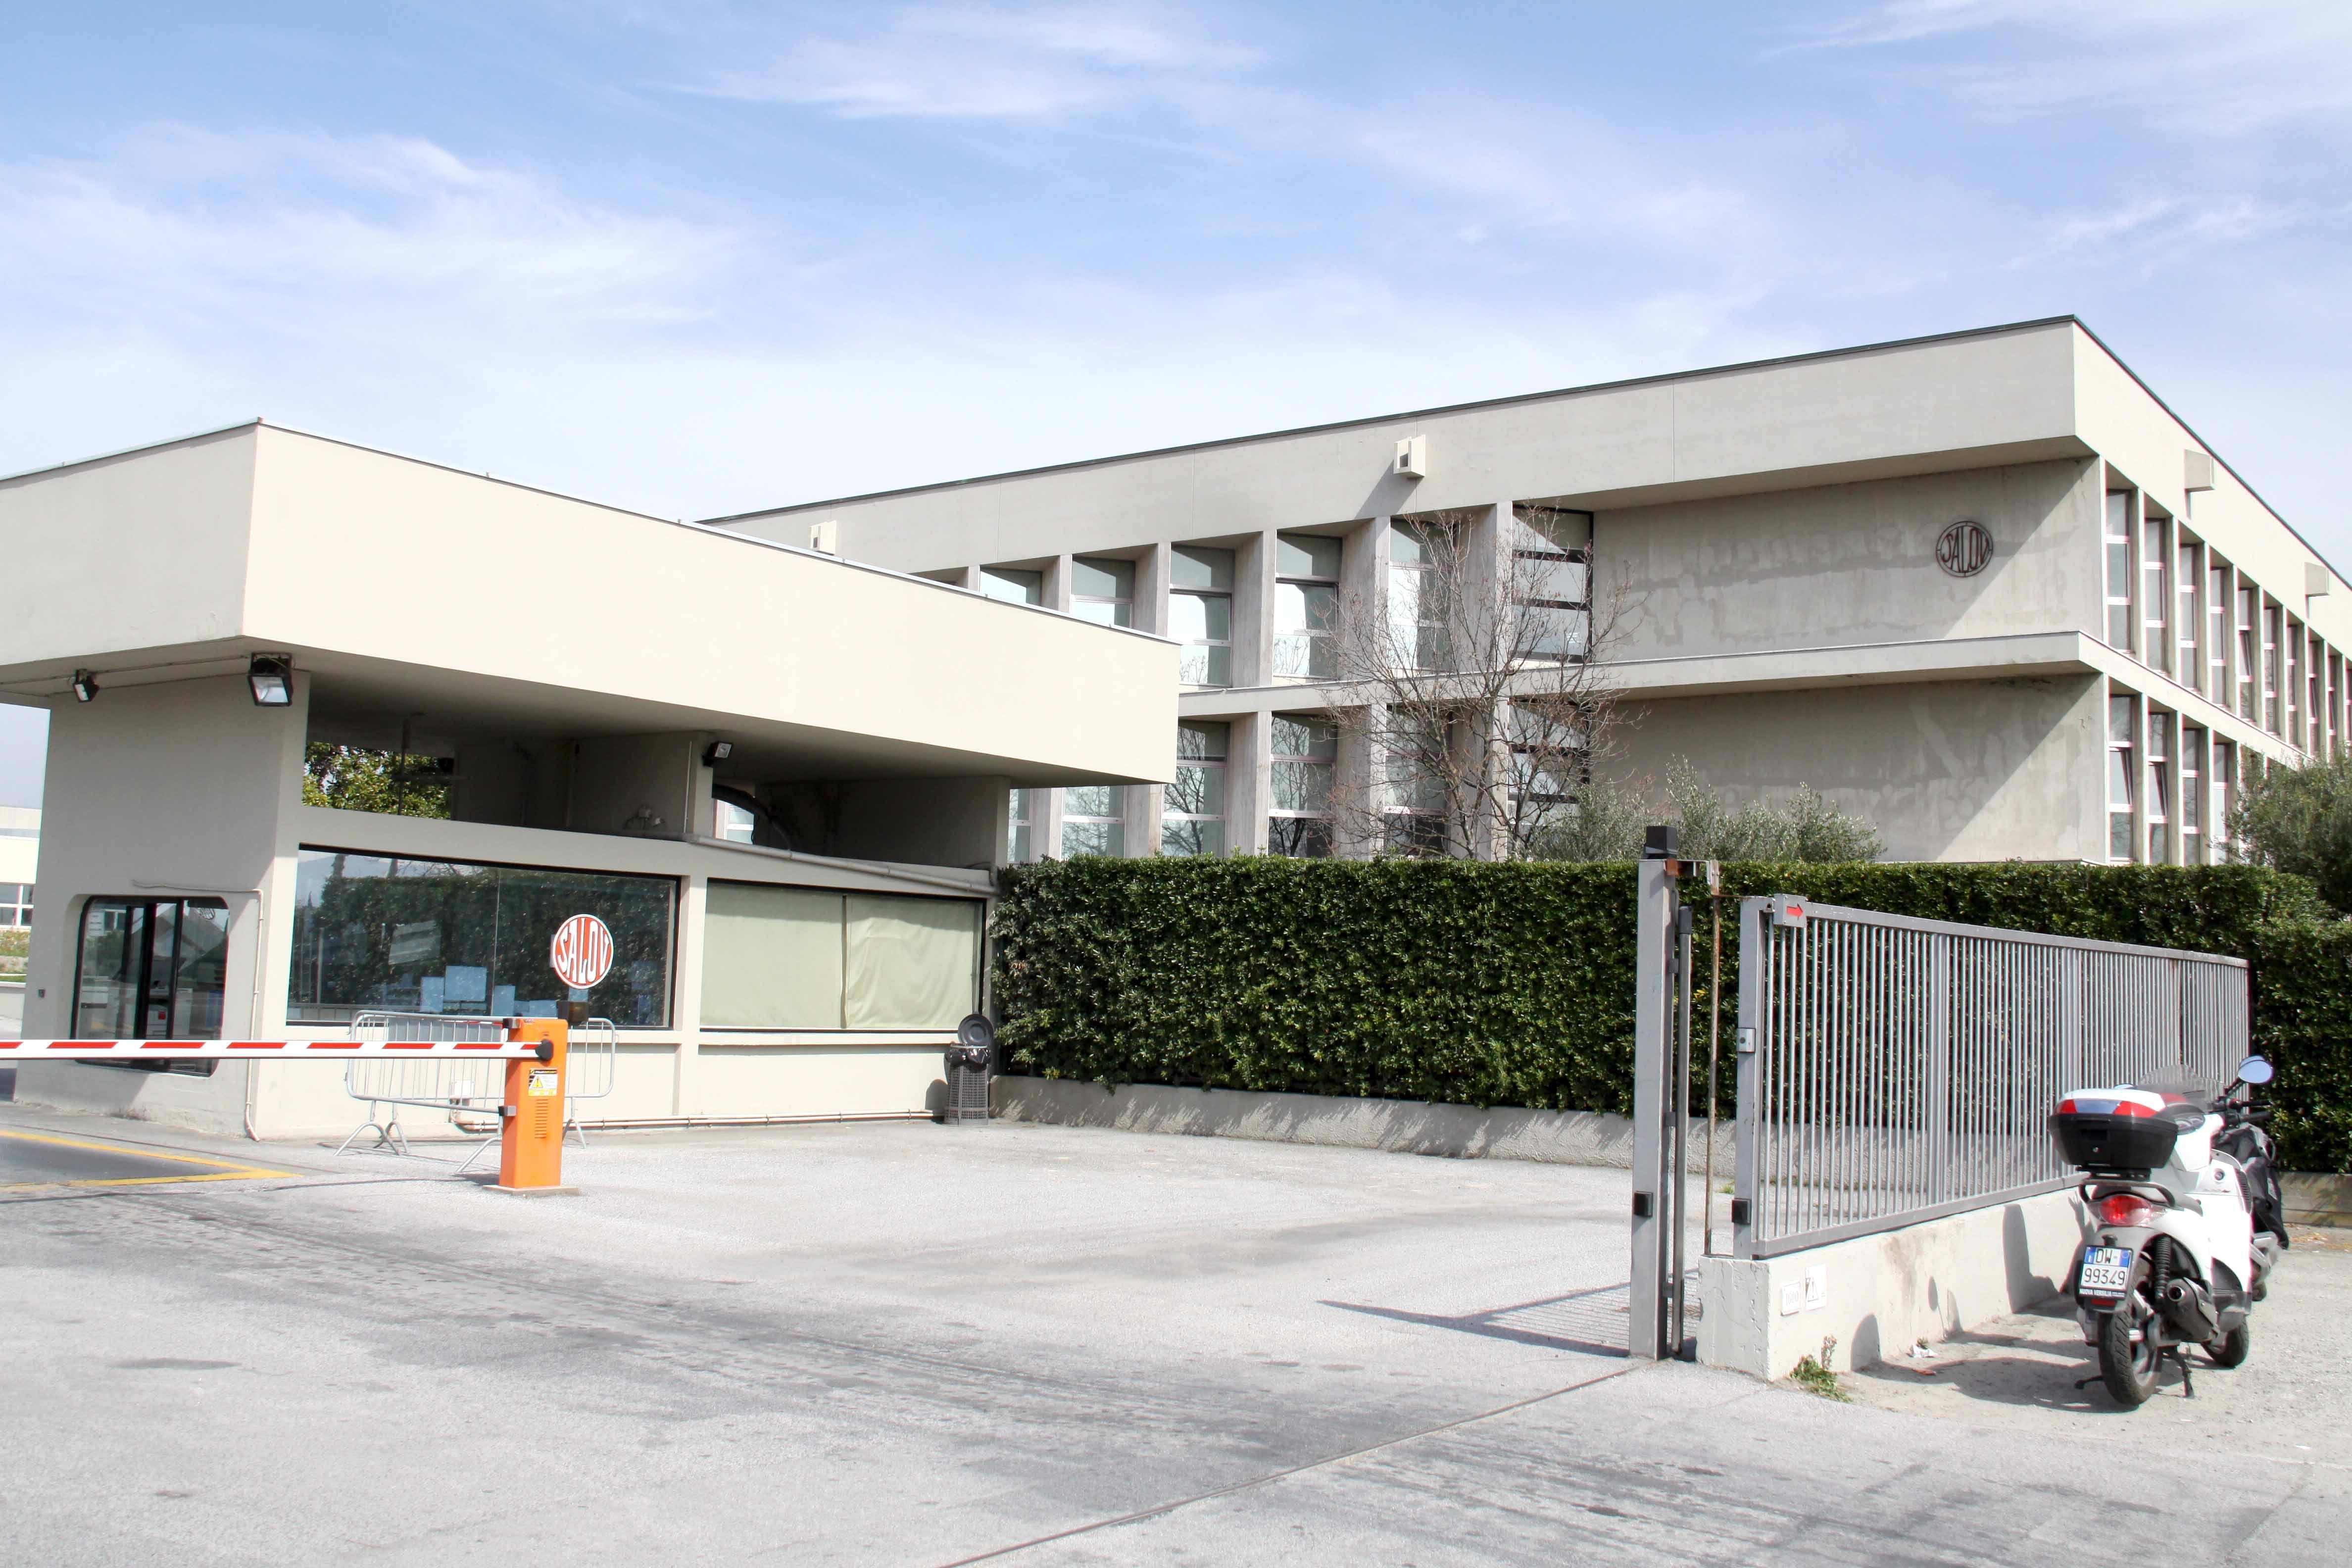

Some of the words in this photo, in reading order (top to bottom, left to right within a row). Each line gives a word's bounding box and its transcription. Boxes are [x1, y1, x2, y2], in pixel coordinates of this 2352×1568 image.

[1941, 526, 1990, 573] SALOV
[558, 918, 610, 984] SALOV
[2096, 1249, 2113, 1264] DW
[2084, 1268, 2125, 1285] 99349
